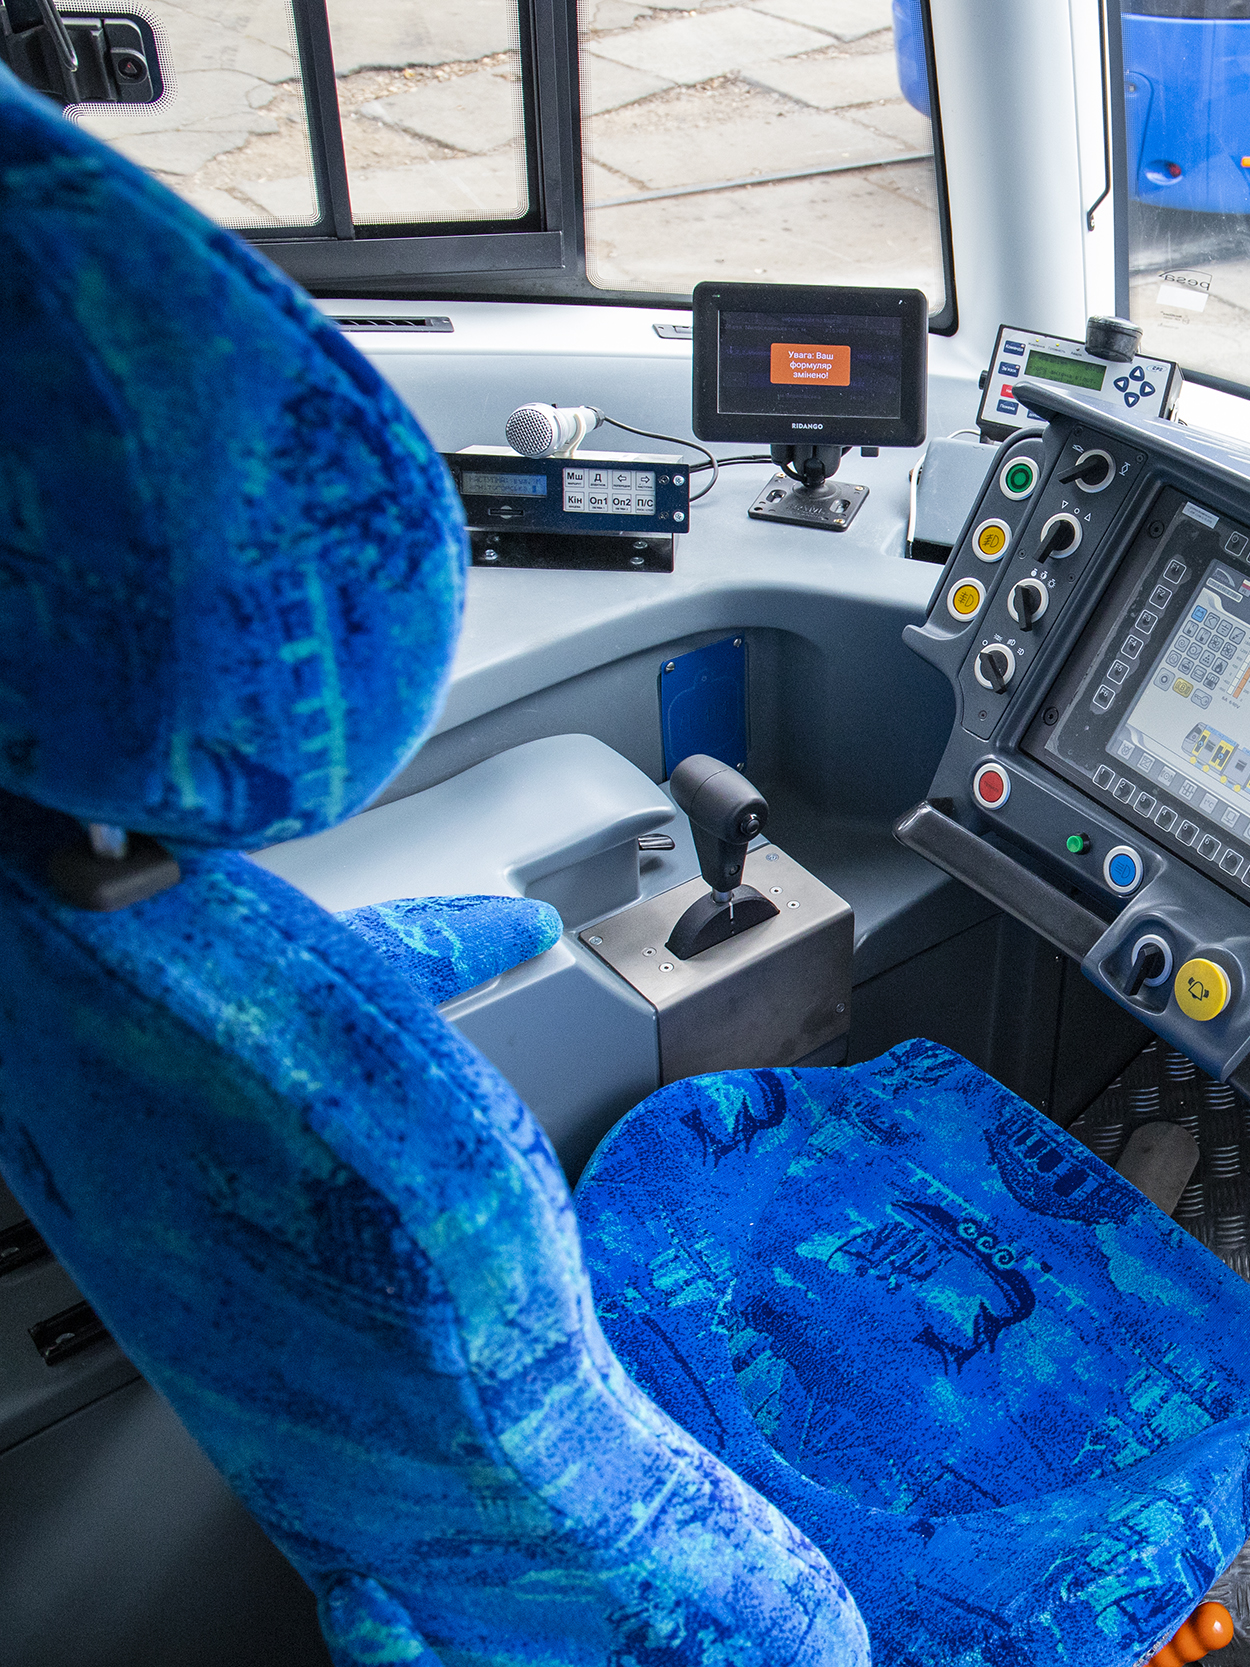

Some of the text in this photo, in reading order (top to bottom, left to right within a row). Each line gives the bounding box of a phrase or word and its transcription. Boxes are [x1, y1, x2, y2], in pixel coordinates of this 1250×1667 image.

[788, 350, 834, 360] Увага: Ваш
[790, 360, 832, 371] формуляр
[793, 371, 829, 380] змінено!
[567, 472, 583, 482] Мш
[594, 473, 602, 484] Д
[568, 496, 583, 506] Кін
[589, 496, 608, 506] Оп1
[612, 498, 632, 507] Оп2
[637, 499, 654, 508] П/С
[1170, 562, 1180, 572] F1
[1156, 589, 1166, 598] F2
[1142, 614, 1152, 622] F3
[1128, 638, 1138, 647] F4
[1114, 664, 1123, 672] F5
[1100, 688, 1109, 697] F6
[1120, 780, 1126, 788] 2
